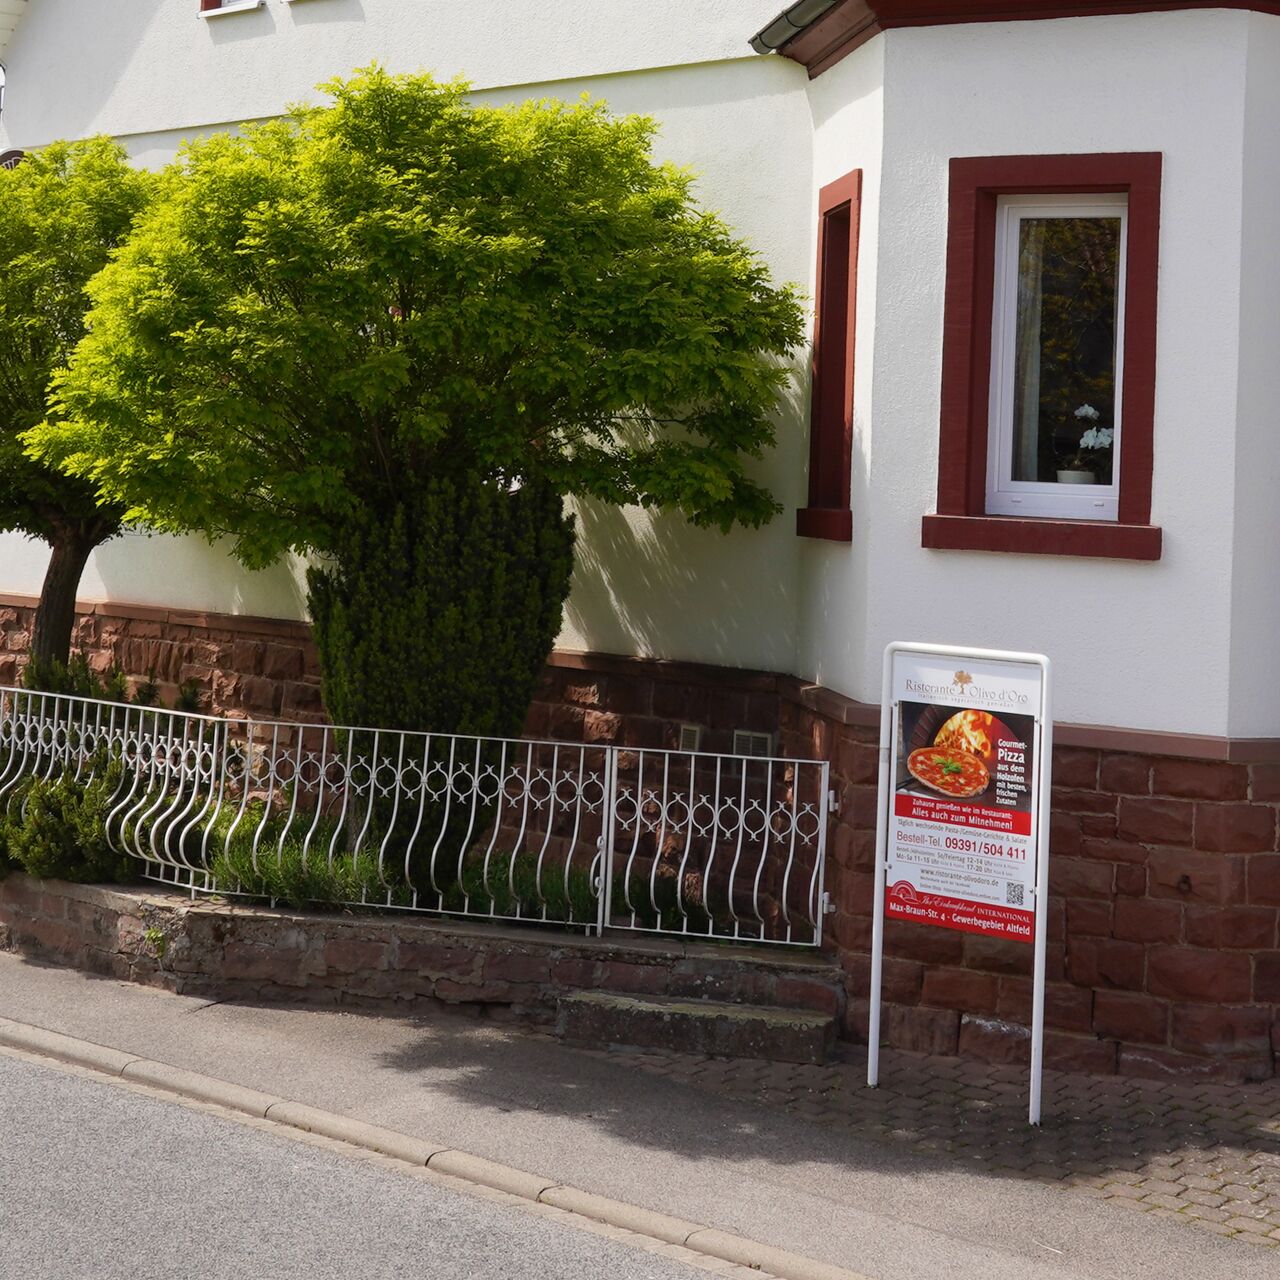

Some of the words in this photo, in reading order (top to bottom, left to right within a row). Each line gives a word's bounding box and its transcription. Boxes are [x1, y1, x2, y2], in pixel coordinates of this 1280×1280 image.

[905, 679, 955, 695] Ristorante
[969, 686, 996, 699] Olivo
[998, 689, 1029, 704] d'Oro
[998, 738, 1027, 750] Gourmet-
[998, 748, 1025, 763] Pizza
[997, 763, 1009, 771] aus
[1010, 764, 1025, 773] dem
[996, 772, 1025, 783] Holzofen
[996, 788, 1018, 798] frischen
[1007, 782, 1027, 792] besten,
[996, 796, 1017, 806] Zutaten
[912, 798, 934, 808] Zuhause
[936, 801, 960, 812] genießen
[962, 806, 971, 814] wie
[973, 807, 980, 815] im
[981, 808, 1013, 820] Restaurant:
[912, 808, 929, 817] Alles
[931, 811, 948, 820] auch
[951, 814, 966, 823] zum
[968, 816, 1013, 830] Mitnehmen!
[915, 822, 944, 832] wechselnde
[897, 831, 942, 847] Bestell-Tel.
[945, 836, 1003, 856] 09391/504
[1007, 846, 1026, 860] 411
[889, 902, 938, 919] Max-Braun-Str.
[940, 913, 945, 921] 4
[952, 913, 1004, 931] Gewerbegebiet
[1006, 922, 1031, 935] Altfeld
[977, 907, 1031, 923] INTERNATIONAL
